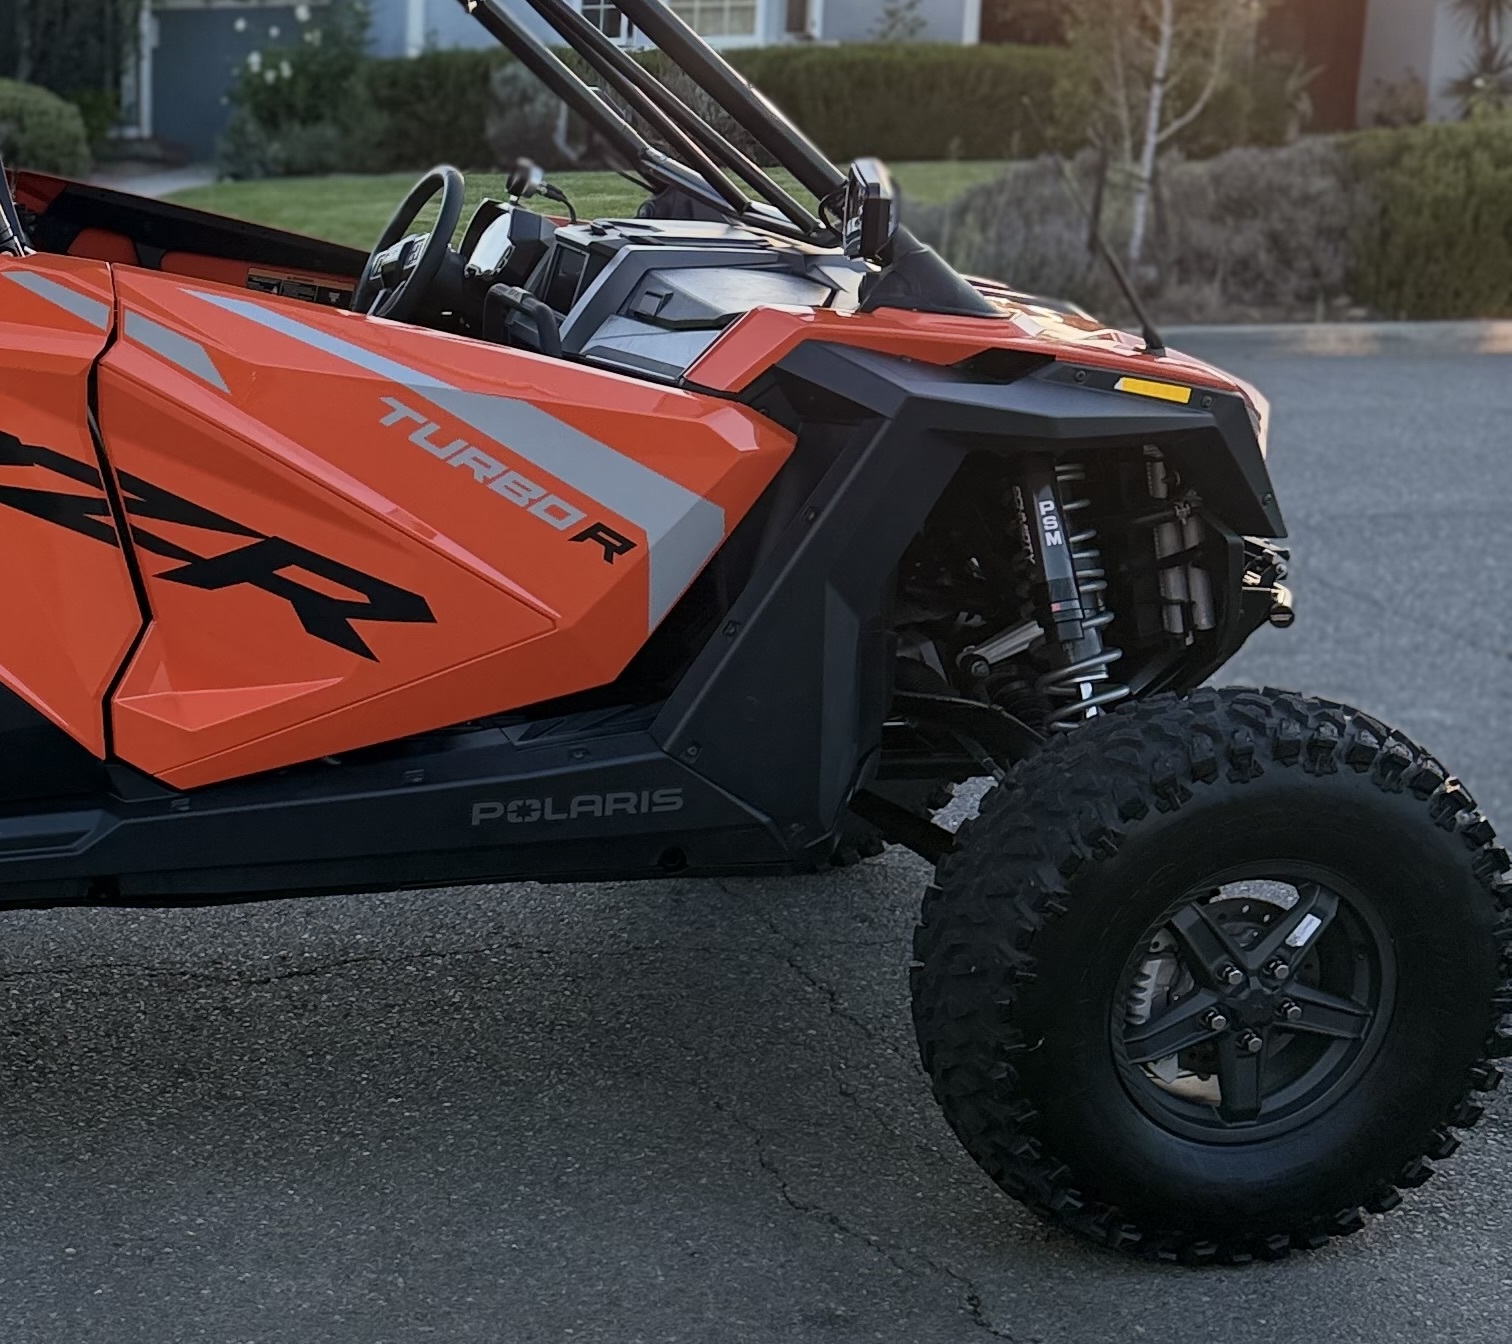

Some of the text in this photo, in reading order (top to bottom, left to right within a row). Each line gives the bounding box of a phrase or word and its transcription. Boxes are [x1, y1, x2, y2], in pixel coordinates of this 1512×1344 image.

[378, 396, 638, 565] TURBO R
[1038, 499, 1063, 547] PSM
[471, 787, 684, 826] POLARIS
